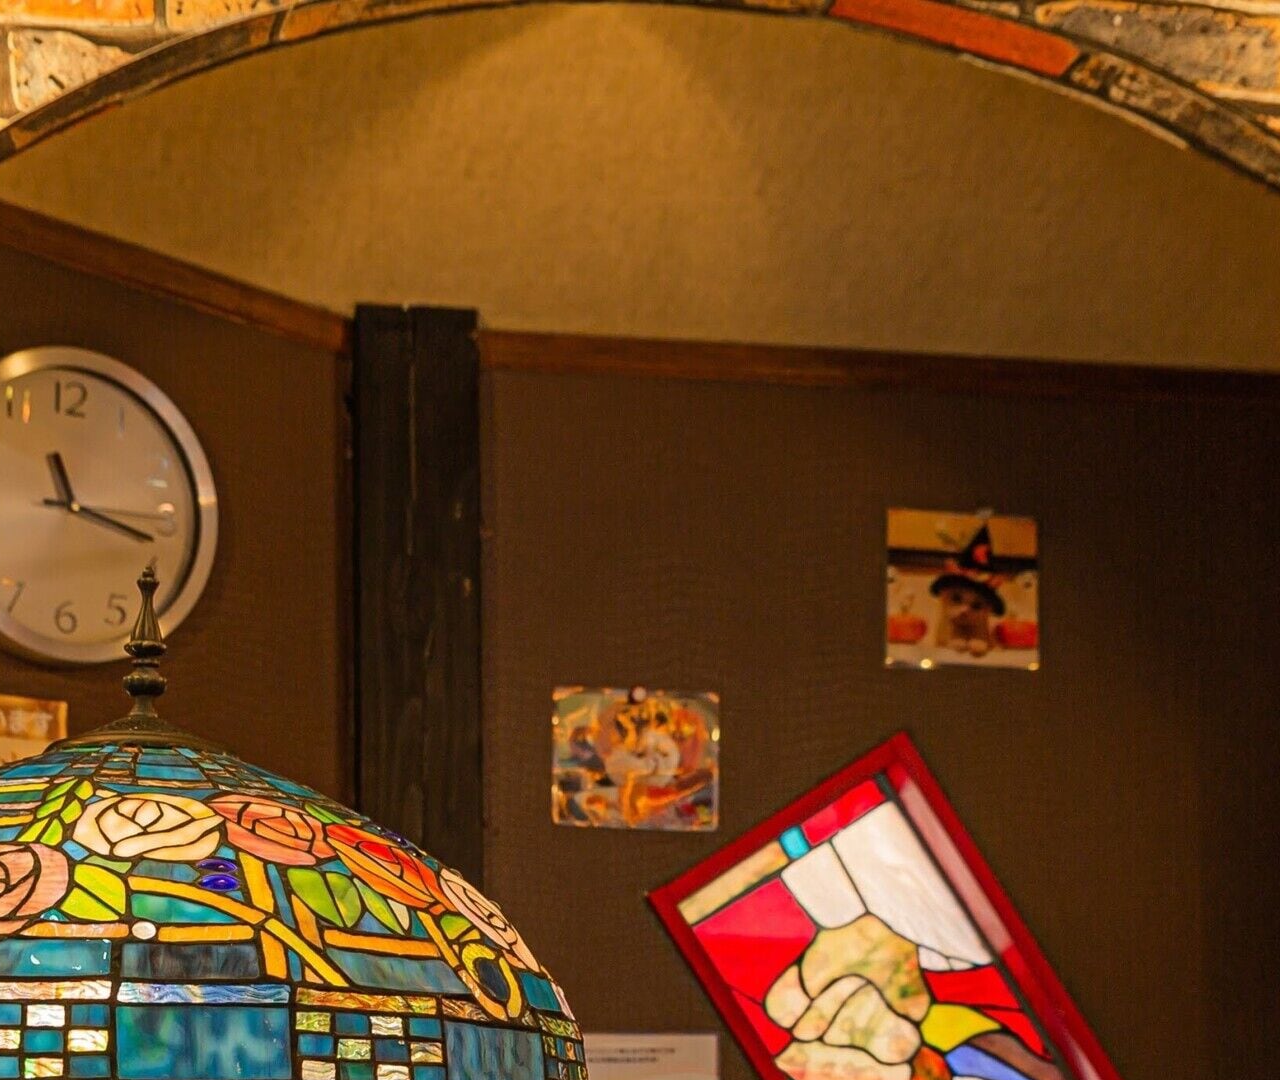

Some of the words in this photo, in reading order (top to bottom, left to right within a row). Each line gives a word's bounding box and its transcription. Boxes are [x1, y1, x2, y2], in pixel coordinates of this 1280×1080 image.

[53, 380, 89, 418] 12
[55, 600, 78, 635] 6
[103, 593, 127, 626] 5
